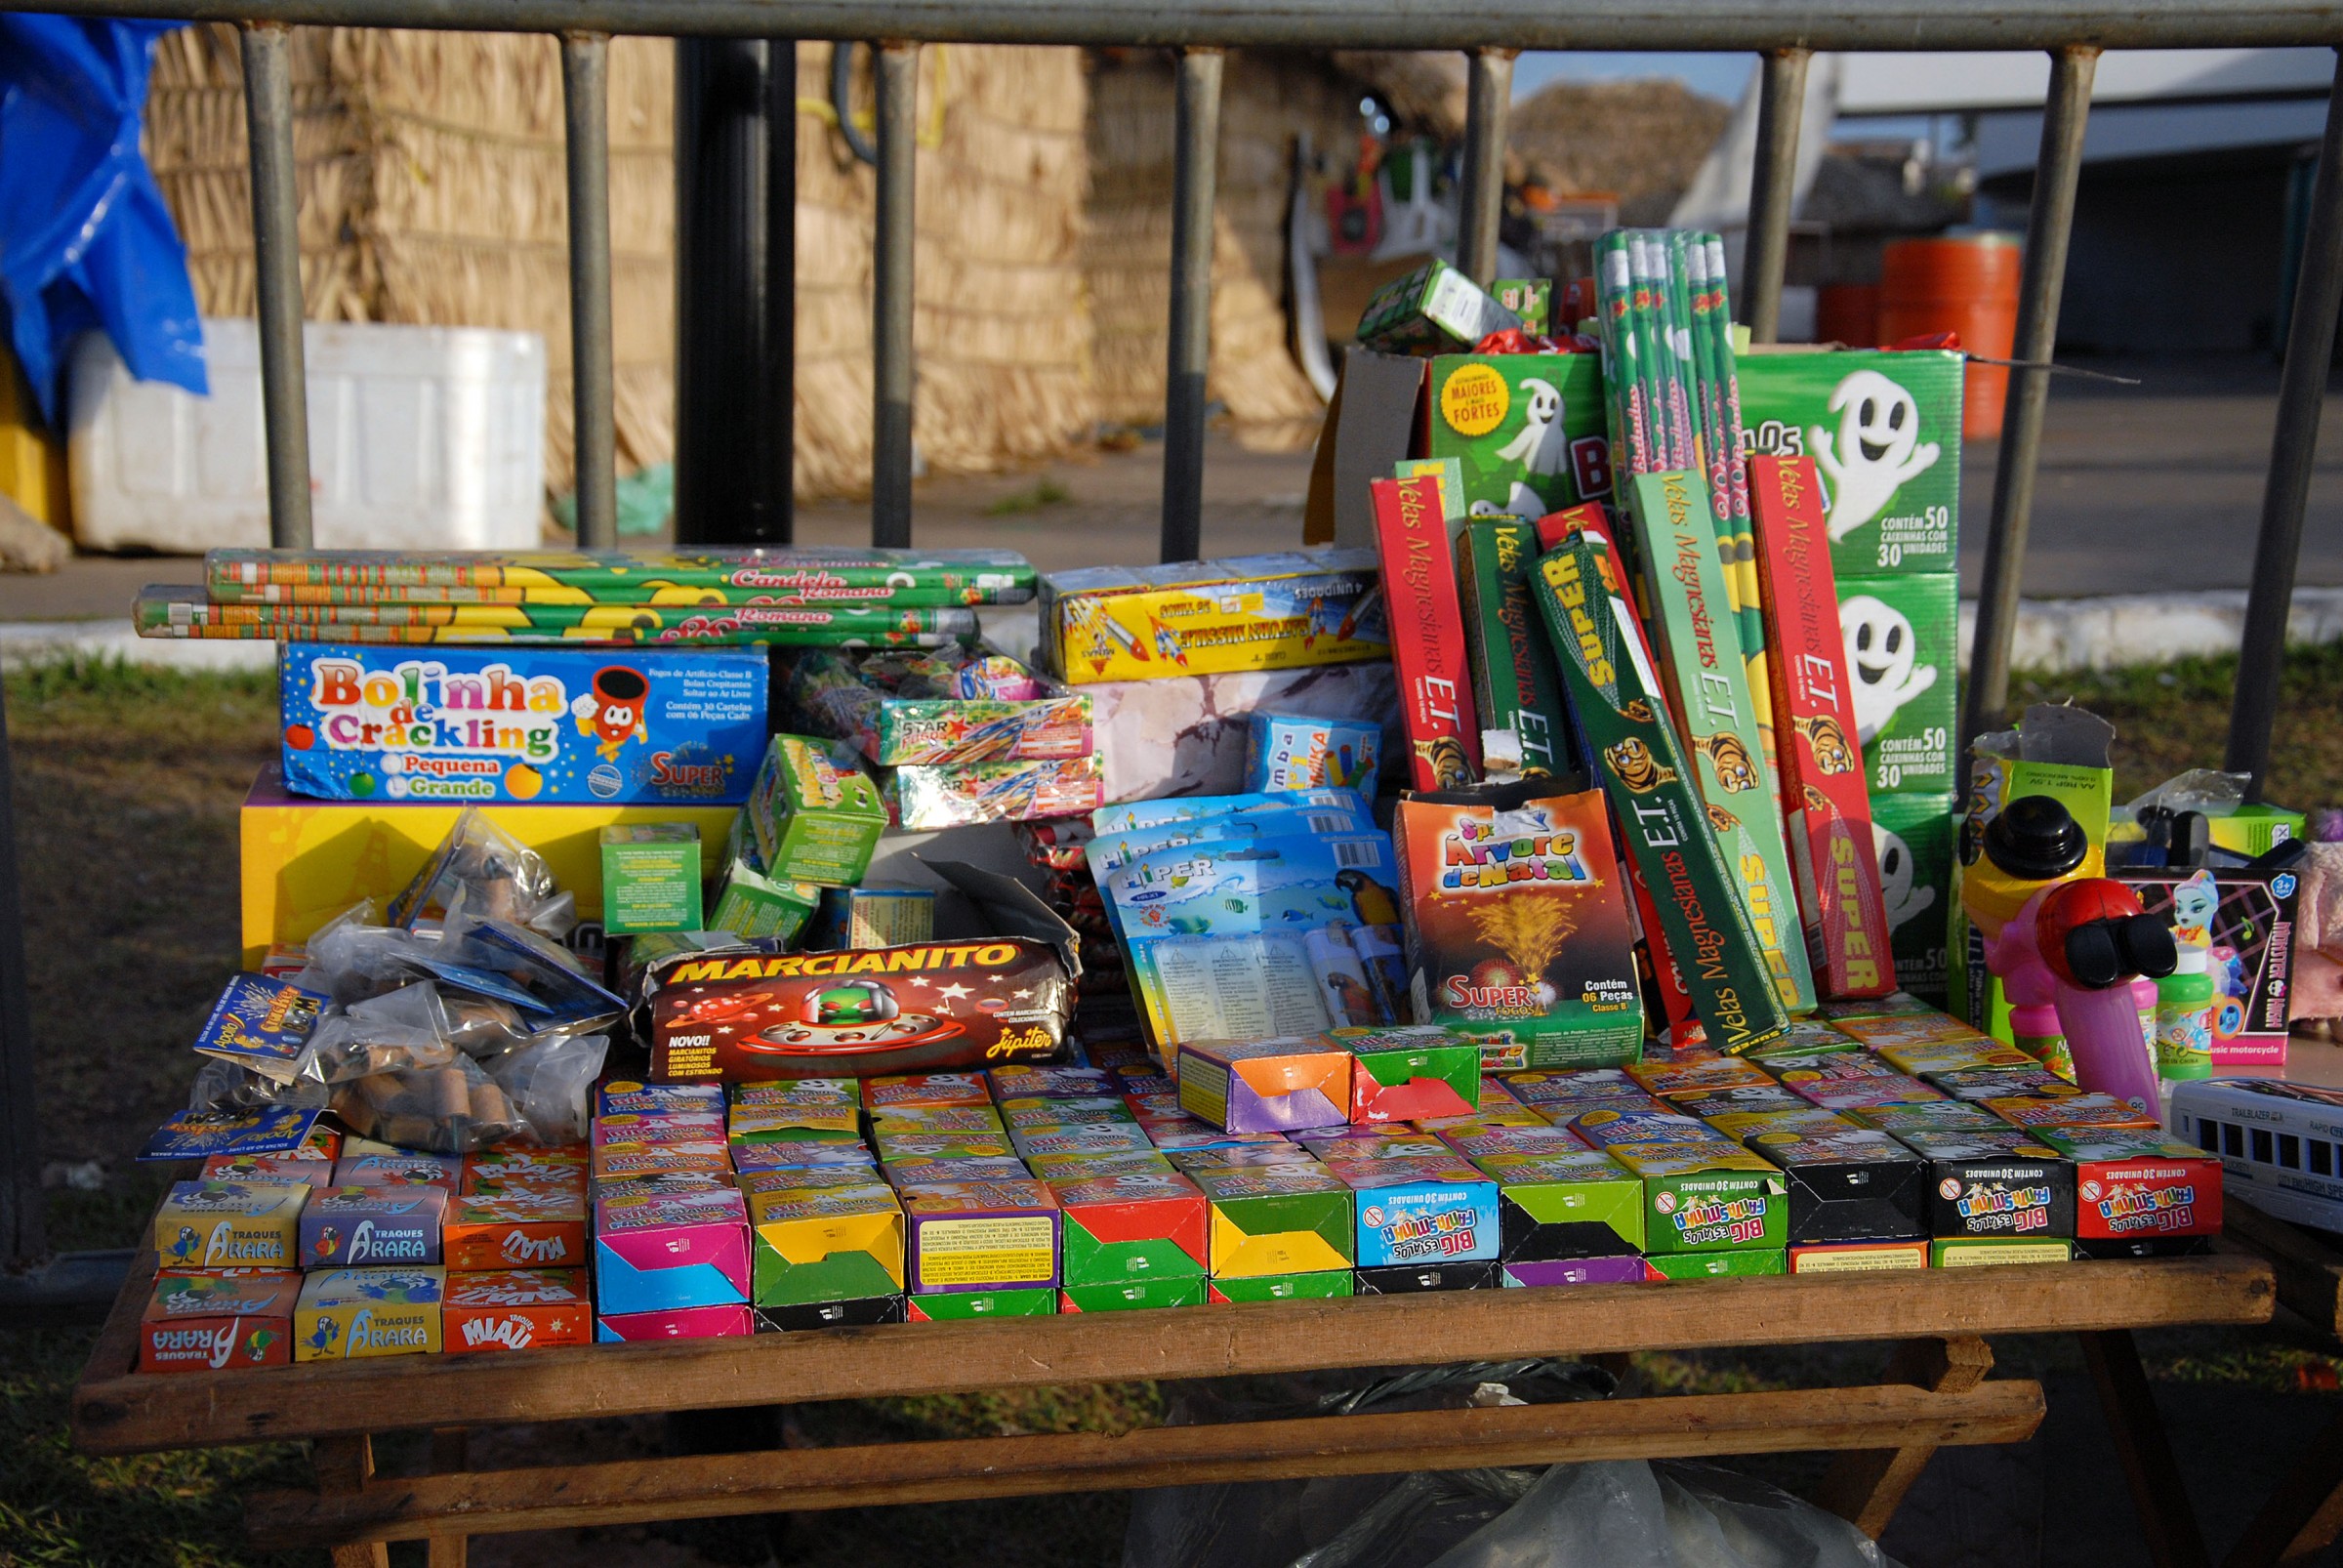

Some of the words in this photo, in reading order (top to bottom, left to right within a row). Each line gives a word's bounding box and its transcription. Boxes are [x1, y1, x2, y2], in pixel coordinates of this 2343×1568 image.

[1452, 380, 1497, 399] MAIORES
[1454, 402, 1500, 423] FORTES
[1777, 458, 1806, 510] Velas
[1396, 477, 1425, 530] Velas
[1662, 474, 1692, 526] Velas
[1881, 514, 1923, 530] CONTÉM
[1925, 506, 1949, 529] 50
[1927, 530, 1948, 541] COM
[1495, 526, 1519, 574] Velas
[1876, 543, 1902, 567] 30
[1903, 543, 1948, 555] UNIDADES
[731, 568, 848, 588] Candela
[800, 585, 895, 599] Romana
[1672, 532, 1718, 670] Magnesianas
[734, 607, 834, 624] Romana
[1403, 536, 1445, 674] Magnesianas
[1249, 618, 1309, 641] SATURN
[1541, 553, 1616, 687] SUPER
[1180, 624, 1245, 648] MISSILE
[674, 668, 683, 677] de
[318, 663, 562, 713] Bolinha
[390, 699, 433, 724] de
[666, 701, 702, 710] Contém
[704, 702, 715, 711] 30
[716, 702, 753, 711] Cartelas
[329, 714, 552, 757] Crackling
[903, 721, 948, 735] STAR
[1880, 735, 1922, 752] CONTÉM
[1923, 727, 1946, 751] 50
[405, 757, 500, 775] Pequena
[1925, 753, 1946, 763] COM
[1876, 764, 1901, 788] 30
[1902, 763, 1946, 774] UNIDADES
[410, 779, 494, 796] Grande
[1443, 868, 1479, 888] de
[1479, 854, 1587, 888] Natal
[2277, 880, 2290, 889] 3+
[1662, 851, 1725, 980] Magnesianas
[1831, 837, 1879, 989] SUPER
[2270, 921, 2291, 979] MONSTER
[671, 943, 1018, 983] MARCIANITO
[1448, 975, 1533, 1008] SUPER
[1584, 979, 1627, 991] Contém
[1583, 992, 1597, 1003] 06
[1600, 990, 1633, 1003] Peças
[1592, 1003, 1620, 1011] Classe
[1622, 1002, 1627, 1011] B
[260, 985, 301, 1033] Cracker
[1496, 1007, 1535, 1015] FOGOS
[1714, 987, 1751, 1044] Velas
[2265, 998, 2285, 1028] HIGH
[213, 1022, 239, 1049] Apollo
[669, 1035, 711, 1048] NOVO!!
[2230, 1046, 2279, 1055] motorcycle
[2232, 1107, 2271, 1120] TRAILBLAZER
[2310, 1120, 2328, 1133] RAPID
[1966, 1170, 2000, 1178] UNIDADES
[2001, 1169, 2013, 1178] 30
[2015, 1170, 2043, 1179] CONTÉM
[2106, 1171, 2142, 1179] UNIDADES
[2143, 1169, 2155, 1179] 30
[2157, 1170, 2186, 1178] CONTÉM
[1680, 1182, 1715, 1191] UNIDADES
[1716, 1180, 1728, 1191] 30
[1730, 1180, 1758, 1190] CONTÉM
[2304, 1178, 2325, 1192] HIGH
[2328, 1184, 2343, 1199] SPE
[1388, 1194, 1423, 1204] UNIDADES
[1425, 1193, 1437, 1204] 30
[1438, 1192, 1467, 1202] CONTÉM
[1957, 1186, 2050, 1217] FANTASMINHA
[2098, 1185, 2194, 1217] FANTASMINHA
[1672, 1198, 1766, 1230] FANTASMINHA
[1967, 1215, 2013, 1231] ESTALOS
[2013, 1207, 2047, 1231] BIG
[2109, 1215, 2157, 1232] ESTALOS
[2158, 1206, 2193, 1230] BIG
[232, 1230, 282, 1240] TRAQUES
[375, 1229, 424, 1238] TRAQUES
[1381, 1209, 1475, 1244] FANTASMINHA
[1684, 1226, 1729, 1244] ESTALOS
[1730, 1217, 1764, 1243] BIG
[204, 1220, 284, 1266] ARARA
[348, 1220, 427, 1264] ARARA
[502, 1230, 566, 1261] MIAU
[1394, 1240, 1439, 1259] ESTALOS
[1440, 1229, 1474, 1256] BIG
[374, 1317, 424, 1327] TRAQUES
[153, 1316, 239, 1369] ARARA
[346, 1309, 428, 1358] ARARA
[461, 1317, 532, 1349] MIAU
